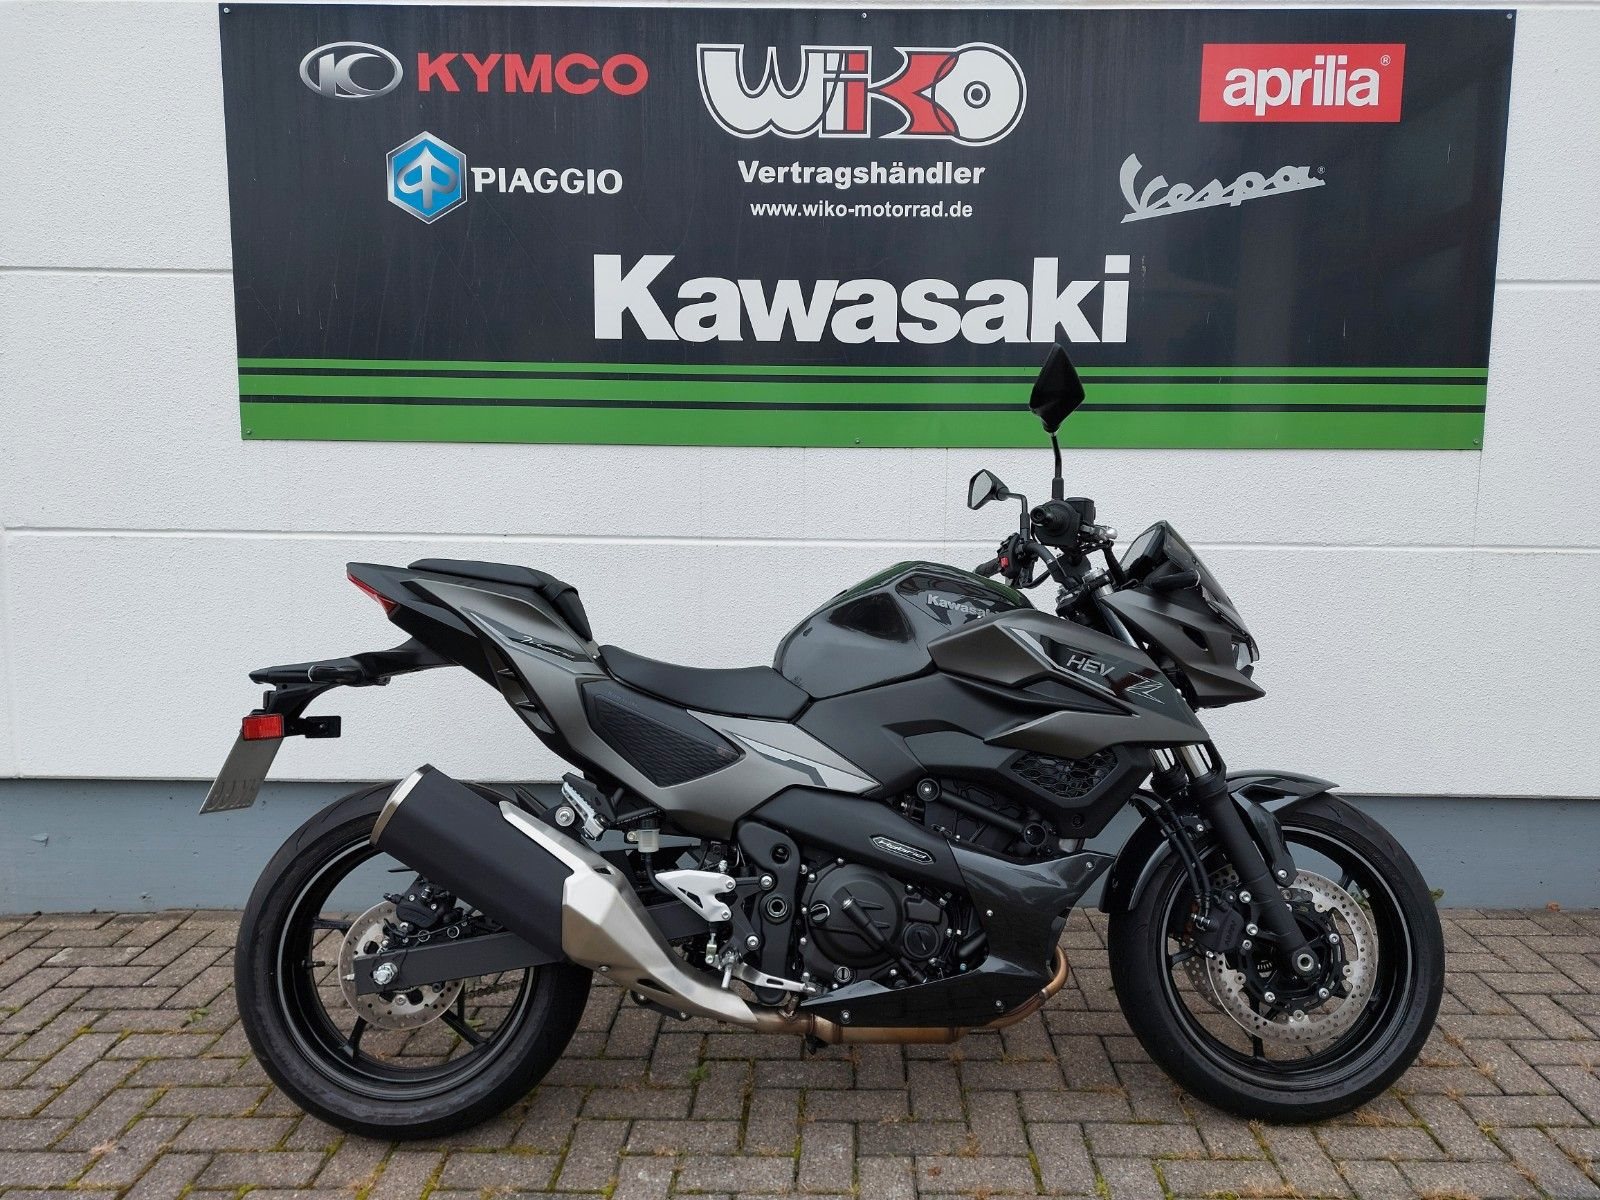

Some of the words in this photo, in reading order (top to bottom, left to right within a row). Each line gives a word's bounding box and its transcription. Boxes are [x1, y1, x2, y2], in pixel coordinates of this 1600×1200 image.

[418, 52, 649, 96] KYMCO
[1222, 54, 1380, 117] aprilia
[470, 167, 623, 195] PIAGGIO
[737, 160, 986, 190] Vertragshändler
[1119, 152, 1326, 224] Vespa
[749, 199, 973, 218] www.wiko-motorrad.de
[593, 254, 1131, 345] Kawasaki
[927, 593, 999, 618] Kawasa
[1066, 654, 1116, 677] HEV
